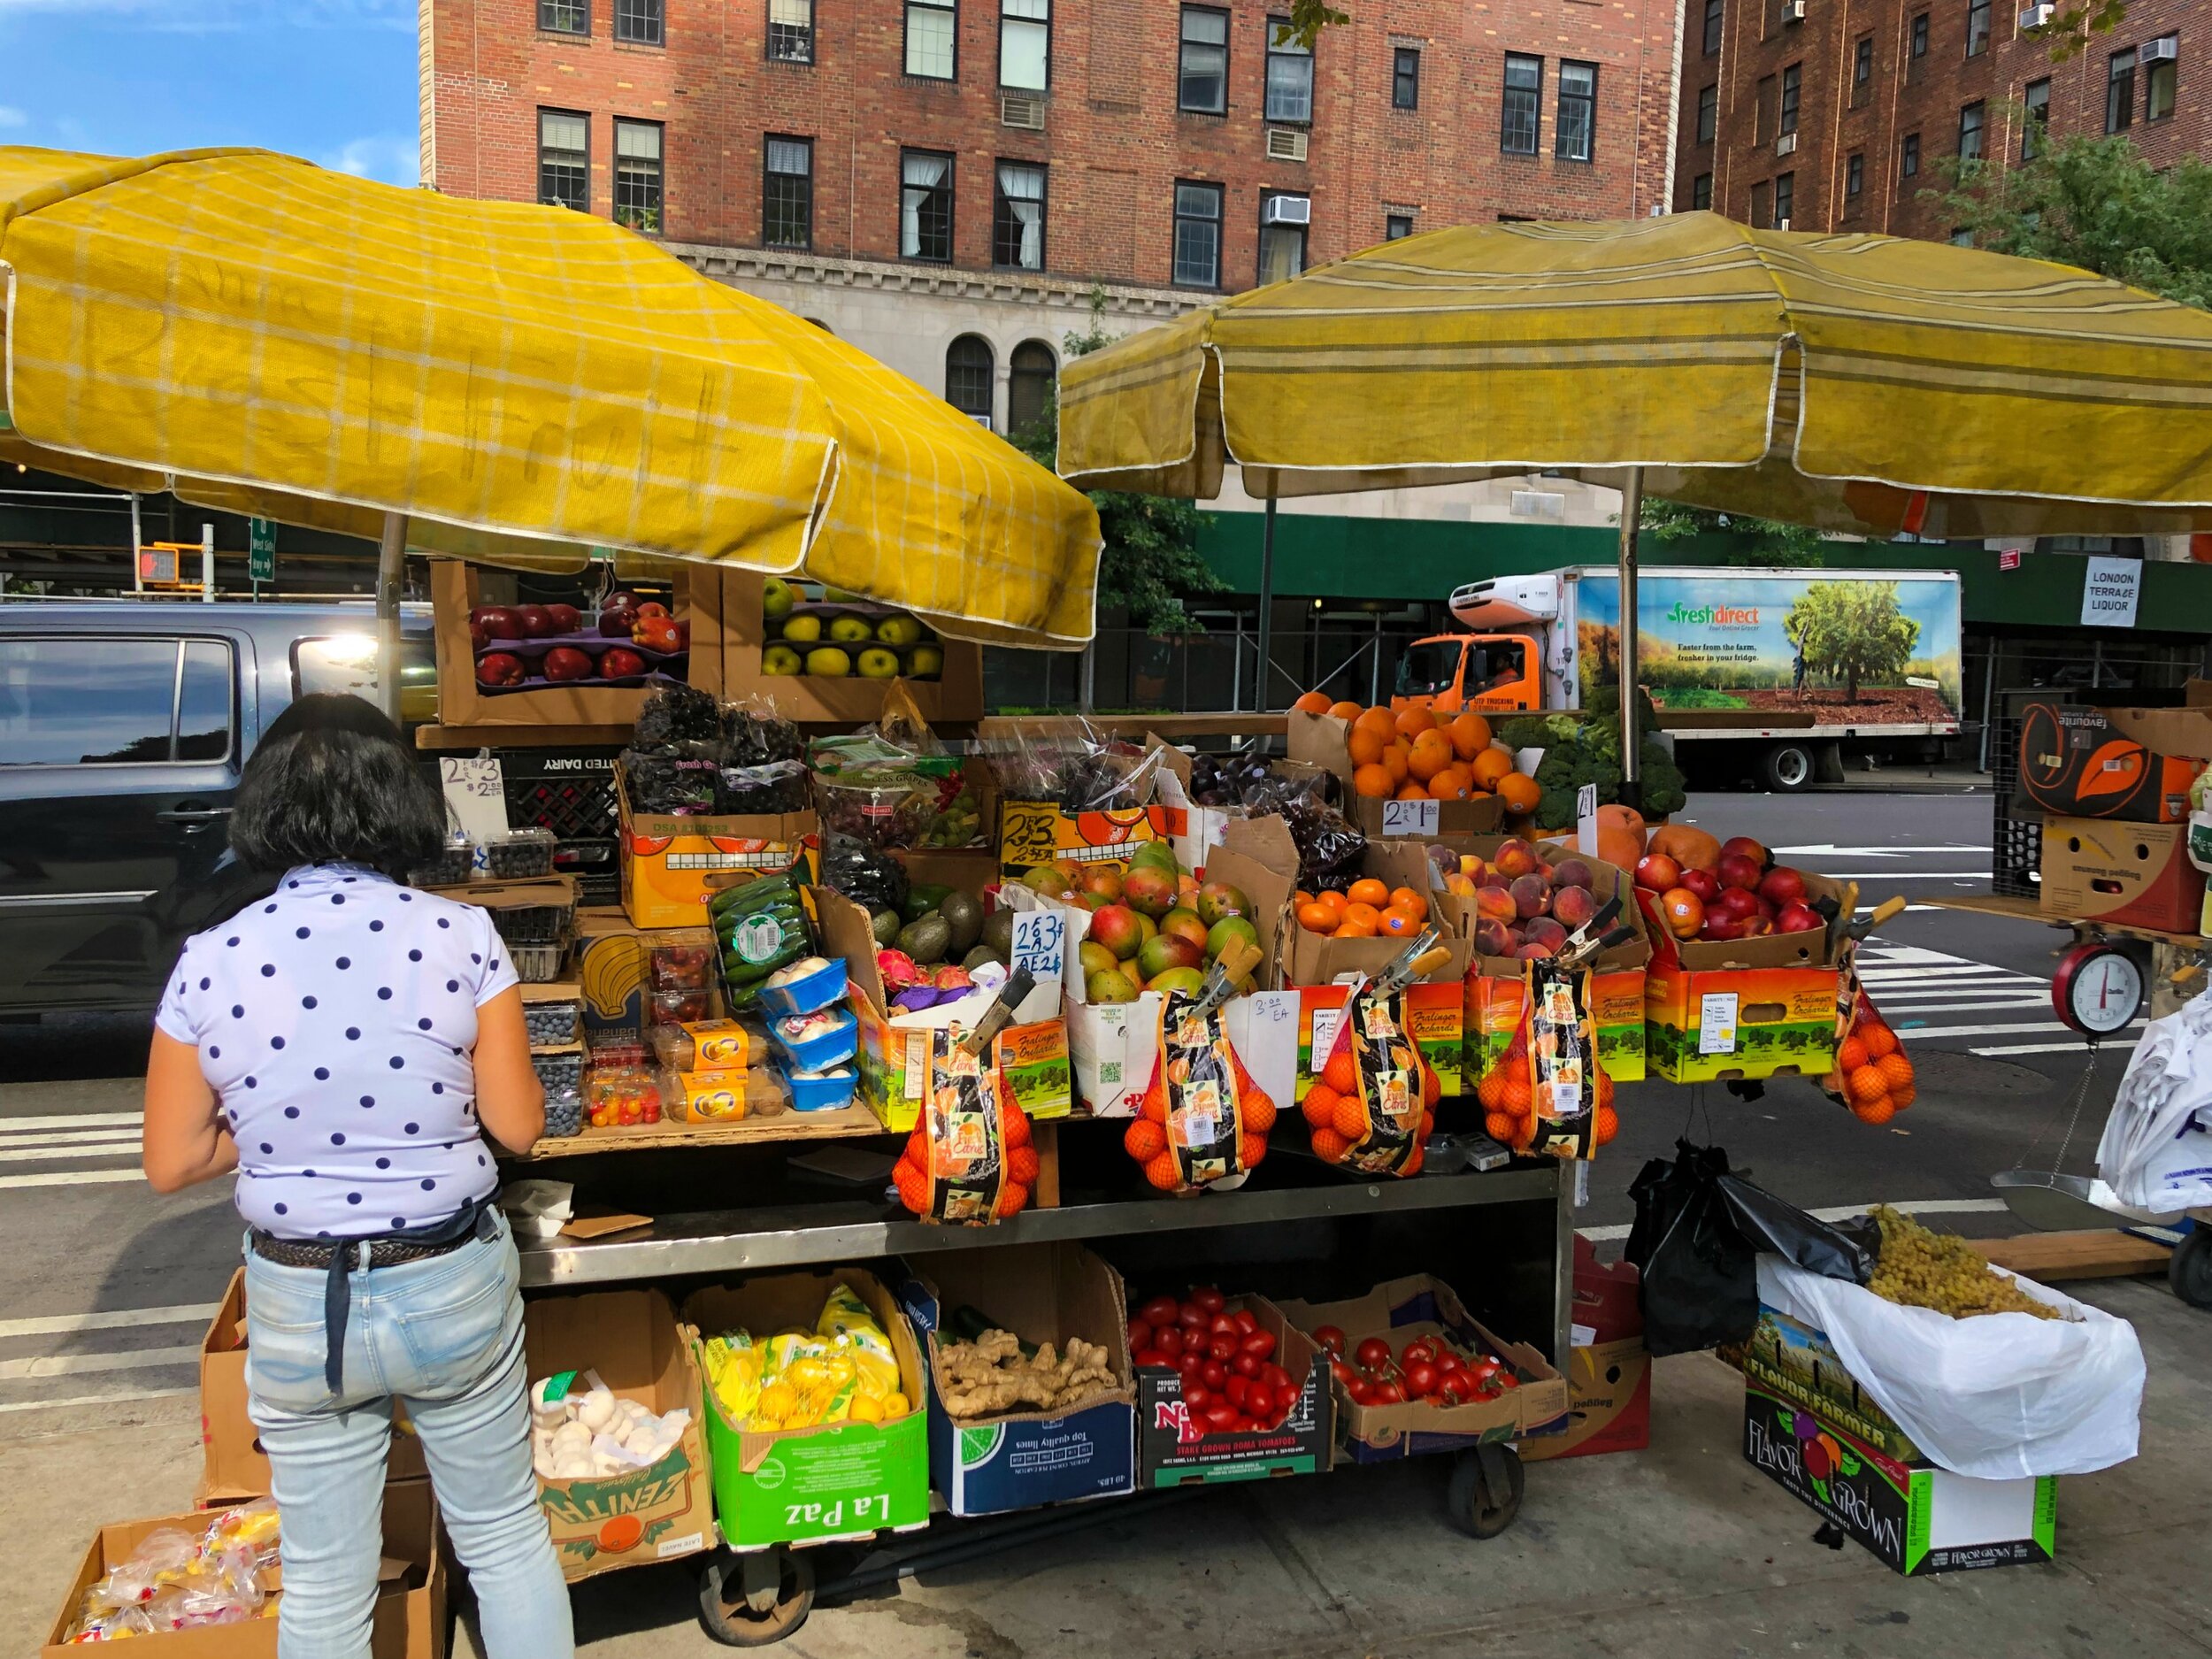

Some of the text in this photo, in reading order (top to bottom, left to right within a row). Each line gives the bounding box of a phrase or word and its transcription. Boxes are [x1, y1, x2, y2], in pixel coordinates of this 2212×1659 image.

[253, 538, 274, 552] West Side
[253, 558, 263, 573] Hwy
[2093, 572, 2134, 584] LONDON
[2090, 587, 2135, 598] TERRACE
[1669, 602, 1759, 624] freshdirect
[2092, 600, 2129, 611] LIQUOR
[1734, 654, 1759, 663] fridge.
[2058, 717, 2107, 730] favourite
[442, 757, 465, 783] 2
[543, 758, 613, 770] ITED DAIRY
[895, 774, 928, 787] GRAPES
[1385, 802, 1402, 826] 2
[1003, 813, 1029, 847] 2
[2071, 865, 2141, 881] Bagged Bananas
[1015, 923, 1033, 949] 2
[1793, 994, 1832, 1006] Fralinger
[1413, 1010, 1457, 1024] Fralinger
[1793, 1004, 1830, 1015] Orchards
[1414, 1022, 1455, 1033] Orchards
[1018, 1033, 1059, 1047] Fralinger
[1019, 1042, 1057, 1057] Orchards
[1750, 1358, 1886, 1450] FLAVOR FARMER
[1016, 1431, 1087, 1450] Top quality limes
[1177, 1436, 1296, 1455] STAKE GROWN ROMA TOMATOES
[1015, 1466, 1037, 1475] CARTON
[1049, 1461, 1069, 1471] COUNT
[595, 1466, 651, 1492] California
[1097, 1475, 1114, 1487] LBS.
[545, 1468, 688, 1525] ZENITH
[1749, 1418, 1803, 1484] FLAVOR
[1832, 1481, 1901, 1562] GROWN
[785, 1494, 889, 1527] La Paz
[1783, 1477, 1851, 1531] TASTE THE DIFFERENCE
[662, 1537, 700, 1552] LATE NAVEL
[1951, 1549, 1980, 1564] FLAVOR
[1981, 1547, 2010, 1559] GROWN
